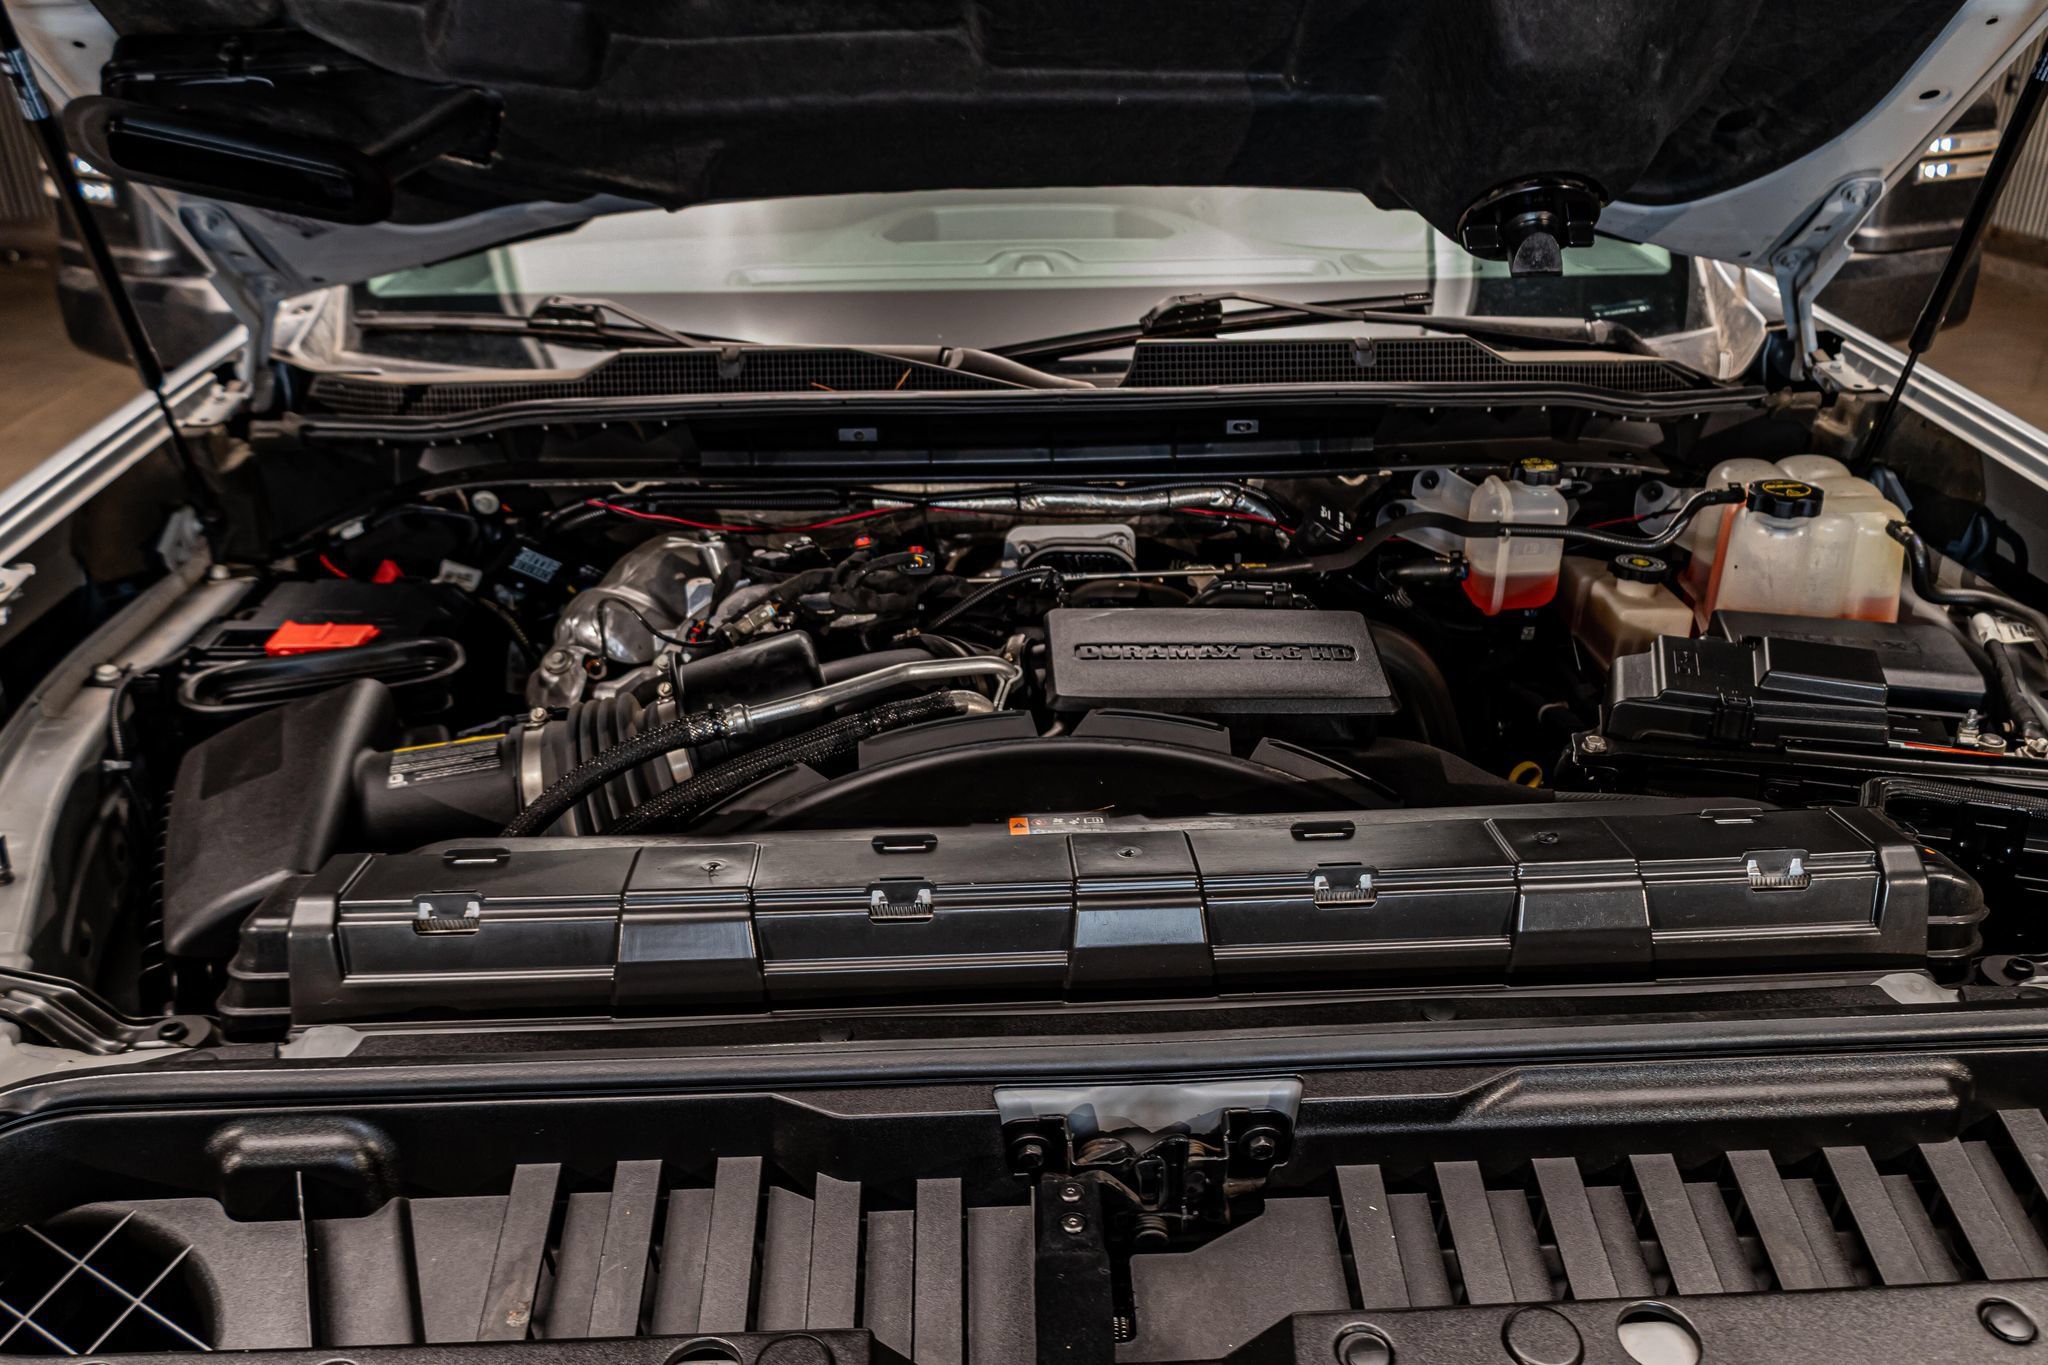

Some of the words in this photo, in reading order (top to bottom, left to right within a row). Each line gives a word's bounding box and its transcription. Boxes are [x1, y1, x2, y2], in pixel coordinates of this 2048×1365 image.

[1078, 645, 1240, 660] DURAMAX
[1253, 646, 1302, 660] 6.6
[1310, 646, 1356, 661] HD
